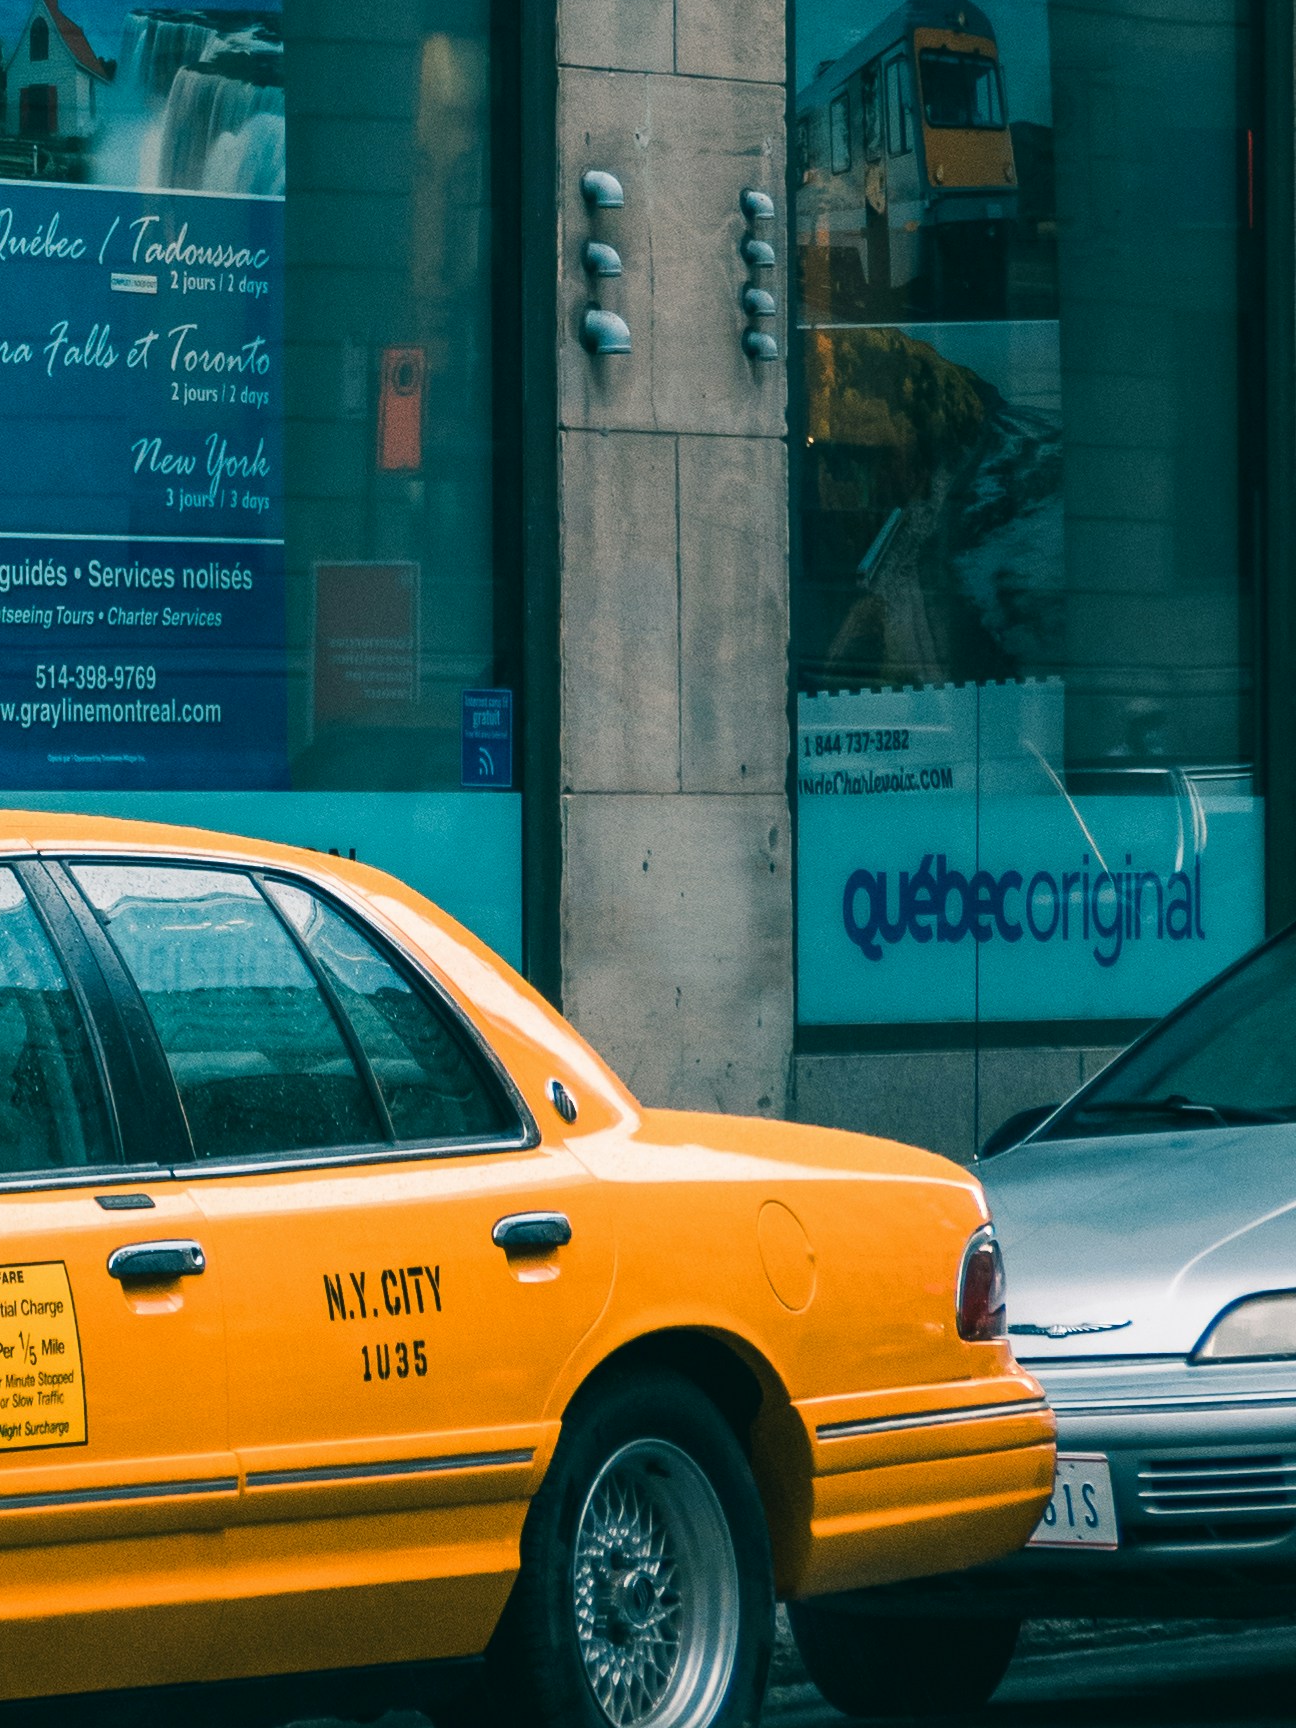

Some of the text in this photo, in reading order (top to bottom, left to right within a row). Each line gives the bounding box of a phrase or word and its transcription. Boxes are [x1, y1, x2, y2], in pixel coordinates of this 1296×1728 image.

[128, 214, 271, 270] Tadoussac
[170, 270, 179, 289] 2
[182, 271, 216, 295] jours
[228, 273, 234, 292] 2
[238, 274, 269, 299] days
[43, 320, 120, 377] Falls
[126, 329, 160, 370] et
[167, 324, 271, 375] Toronto
[171, 381, 269, 410] 2 jours 2 days
[131, 432, 271, 498] New York
[166, 488, 270, 515] 3 jours 3 days
[88, 559, 175, 589] Services
[183, 562, 253, 590] nolisés
[56, 605, 95, 625] Tours
[107, 606, 159, 626] Charter
[161, 607, 223, 627] Services
[35, 664, 157, 690] 514-398-9769
[815, 734, 842, 757] 844
[846, 729, 909, 755] 737-3282
[20, 1299, 64, 1319] Charge
[41, 1338, 65, 1356] Mile
[360, 1340, 429, 1383] 1U35
[5, 1372, 36, 1388] Minute
[38, 1369, 75, 1388] Stopped
[0, 1390, 65, 1409] or Slow Traffic
[24, 1420, 70, 1438] Surcharge
